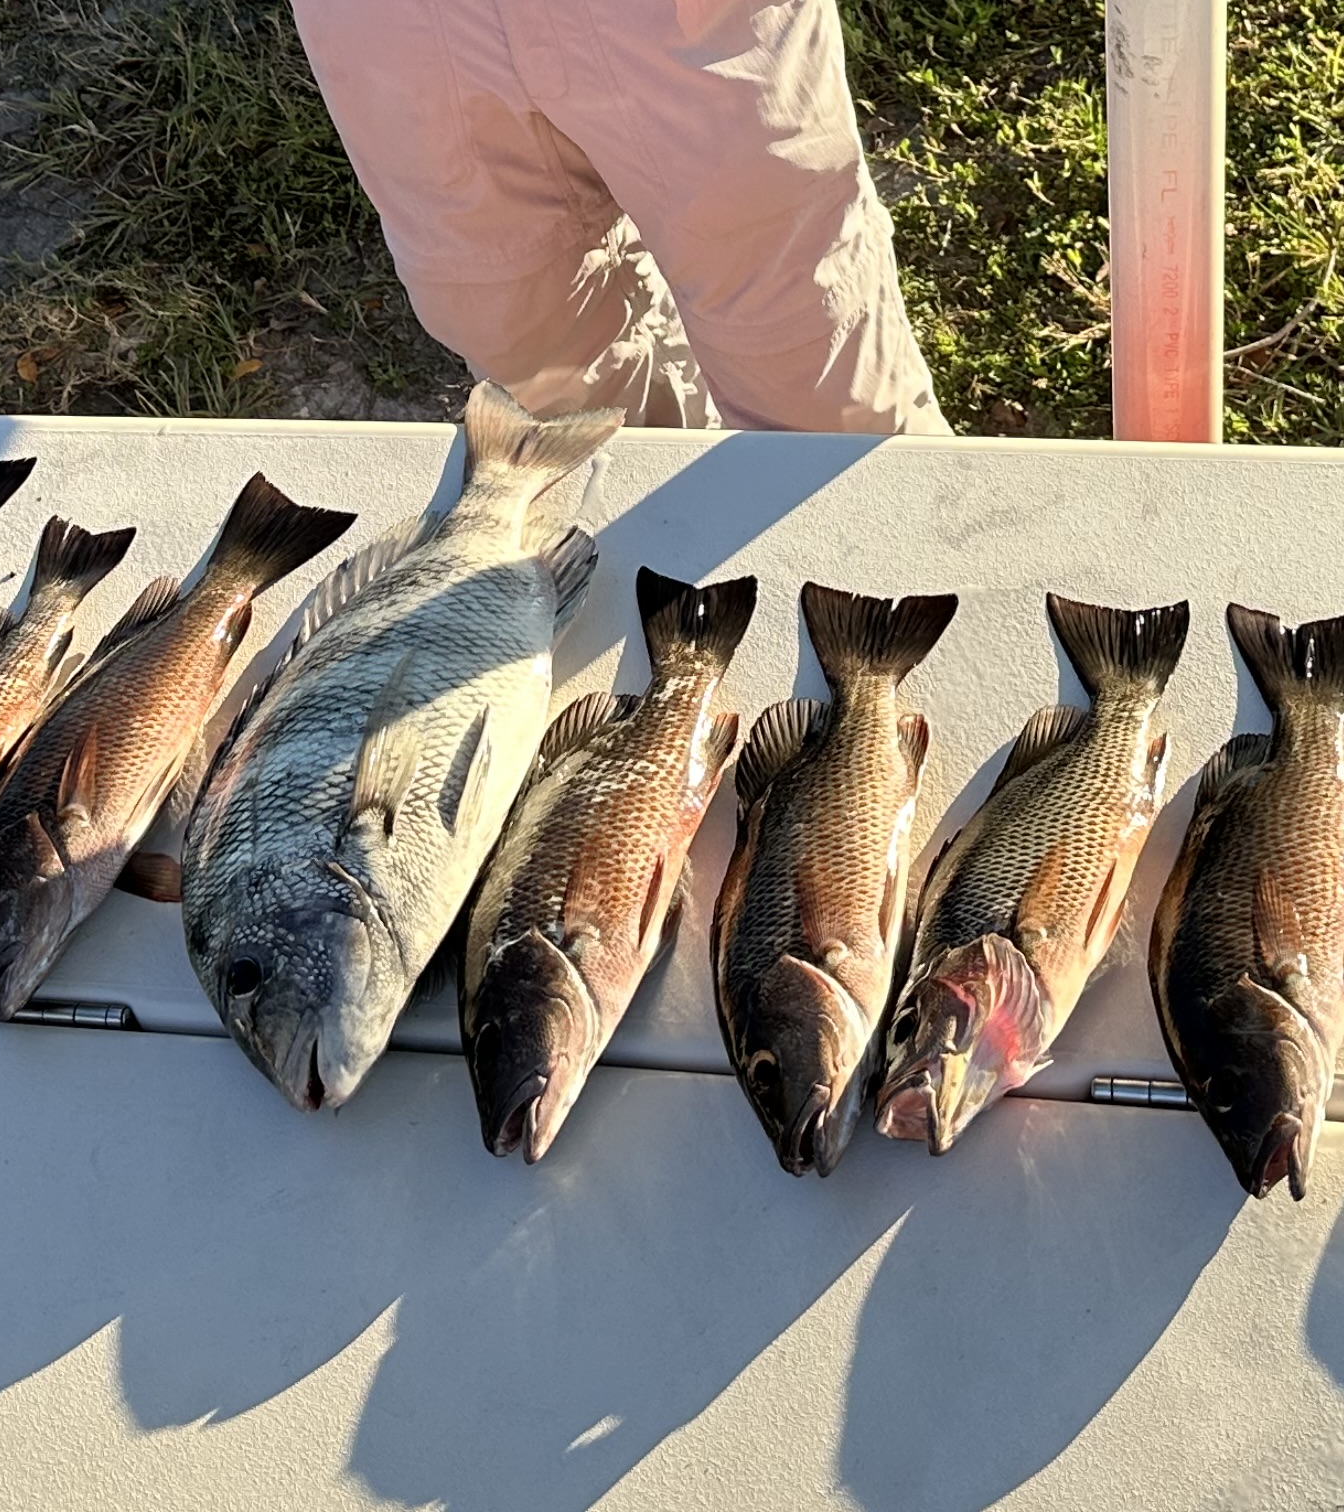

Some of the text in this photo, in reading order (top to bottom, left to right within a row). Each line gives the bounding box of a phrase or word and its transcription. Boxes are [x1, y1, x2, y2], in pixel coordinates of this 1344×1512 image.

[1161, 169, 1178, 204] FL
[1162, 263, 1179, 299] 7200
[1163, 332, 1179, 358] PVC
[1163, 365, 1179, 399] TYPE
